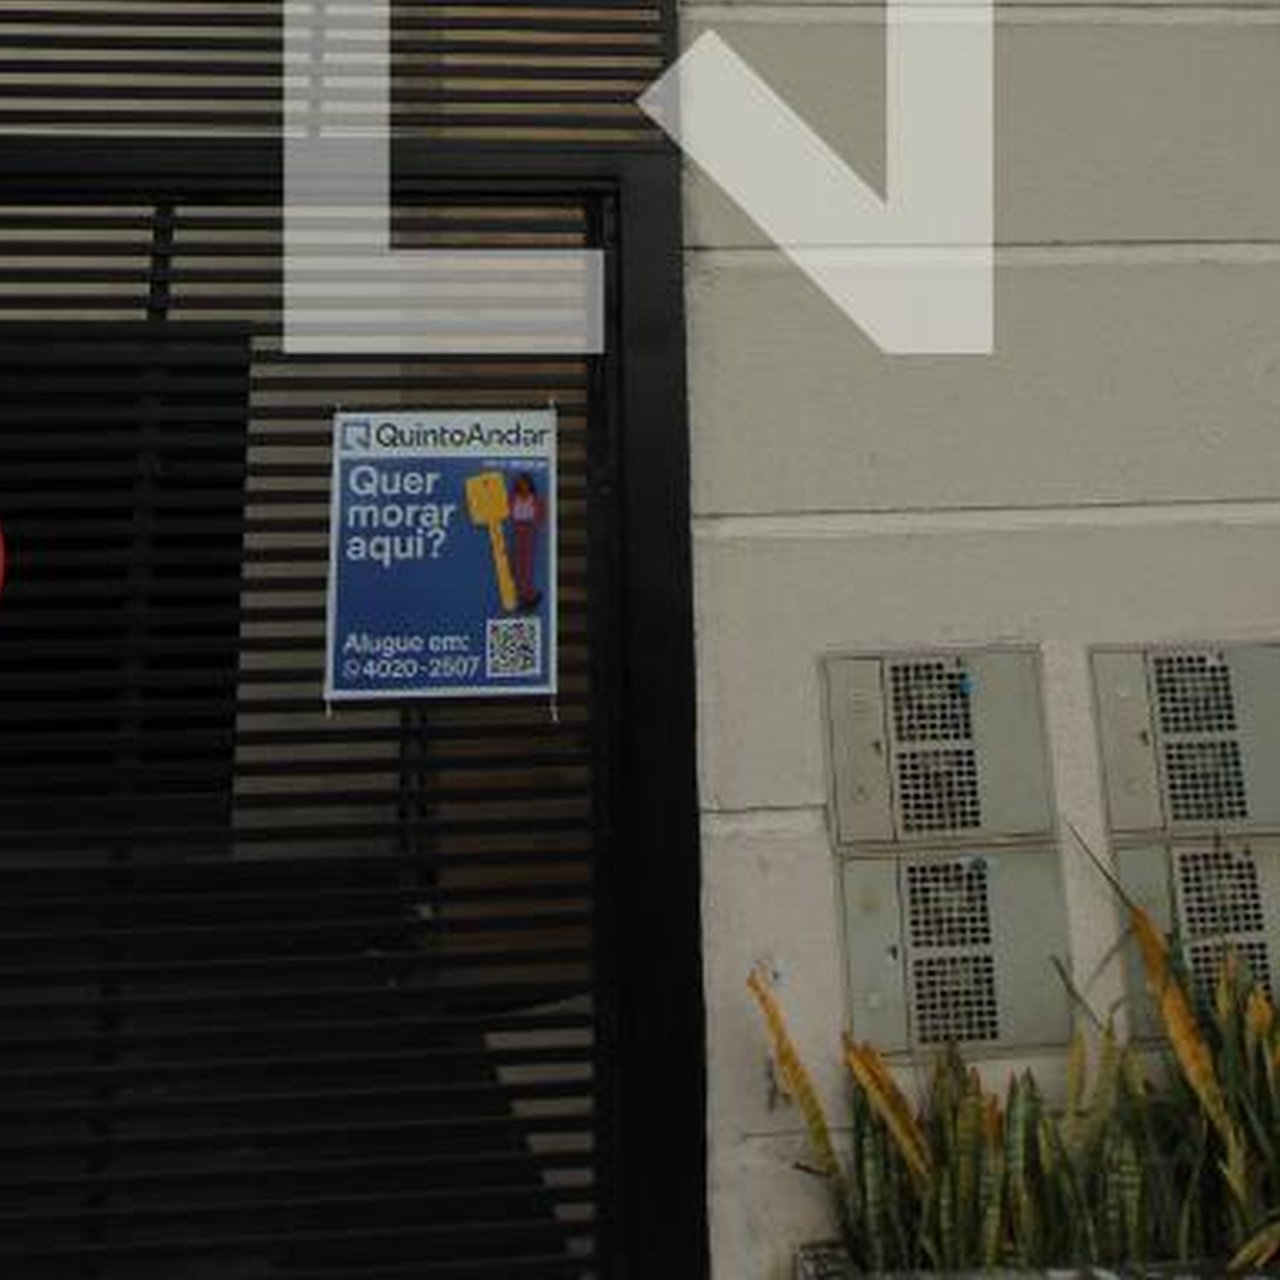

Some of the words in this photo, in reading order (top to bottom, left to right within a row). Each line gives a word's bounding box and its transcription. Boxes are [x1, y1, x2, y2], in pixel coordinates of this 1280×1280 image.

[375, 422, 549, 448] QuintoAndar
[349, 465, 441, 497] Quer
[347, 503, 455, 528] morar
[346, 529, 446, 567] aqui?
[342, 633, 425, 658] Alugue
[428, 634, 469, 652] em:
